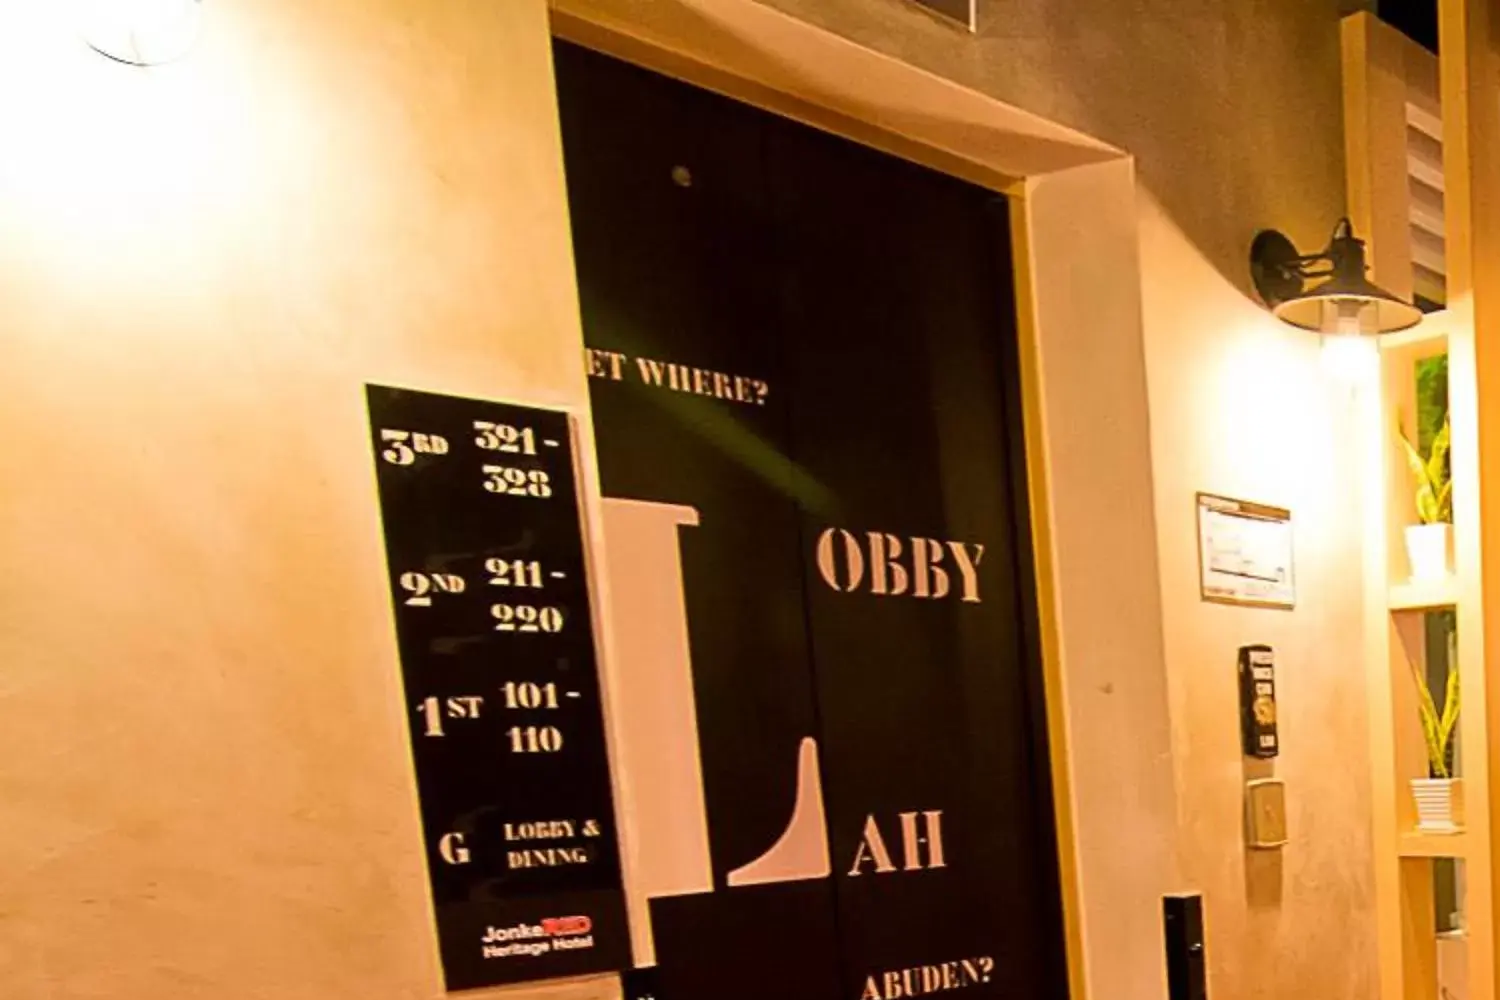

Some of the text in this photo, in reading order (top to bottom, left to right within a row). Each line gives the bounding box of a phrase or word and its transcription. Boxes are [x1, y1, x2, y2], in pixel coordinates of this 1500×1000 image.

[635, 356, 769, 405] WHERE?
[380, 428, 449, 466] 3RD
[481, 464, 552, 498] 328
[400, 571, 466, 607] 2ND
[490, 603, 564, 633] 220
[416, 696, 484, 737] 1ST
[506, 725, 563, 753] 110
[439, 819, 601, 865] G LOBBY &
[507, 848, 588, 869] DINING
[847, 809, 948, 877] AH
[482, 935, 594, 959] Heritage Hotel
